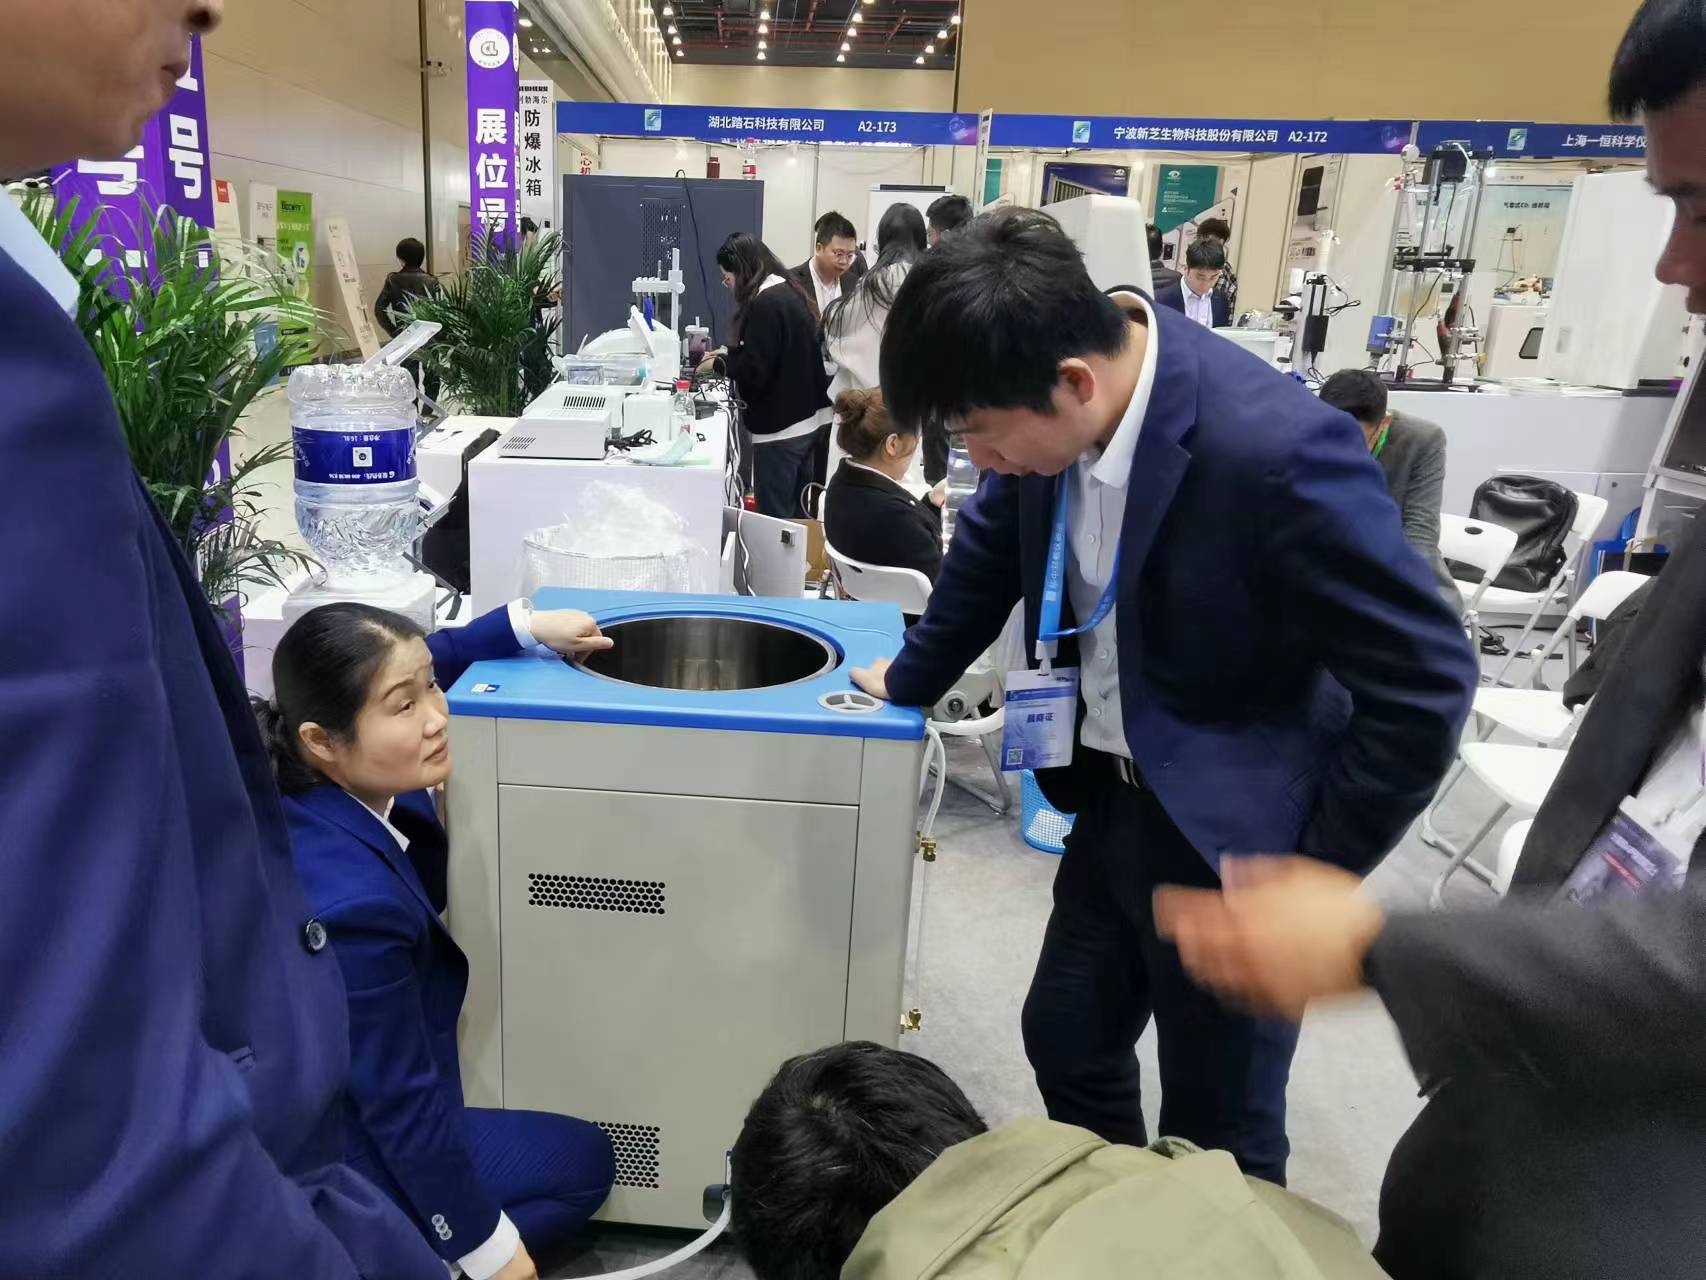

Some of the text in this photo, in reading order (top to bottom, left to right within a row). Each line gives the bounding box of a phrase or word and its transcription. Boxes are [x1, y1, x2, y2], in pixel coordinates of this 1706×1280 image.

[708, 115, 897, 133] 湖北踏石科技有限公司 A2-173
[1113, 126, 1328, 143] 宁波新芝生物科技股份有限公司 A2-172
[475, 108, 508, 233] 展位号
[524, 109, 542, 197] 防爆冰箱
